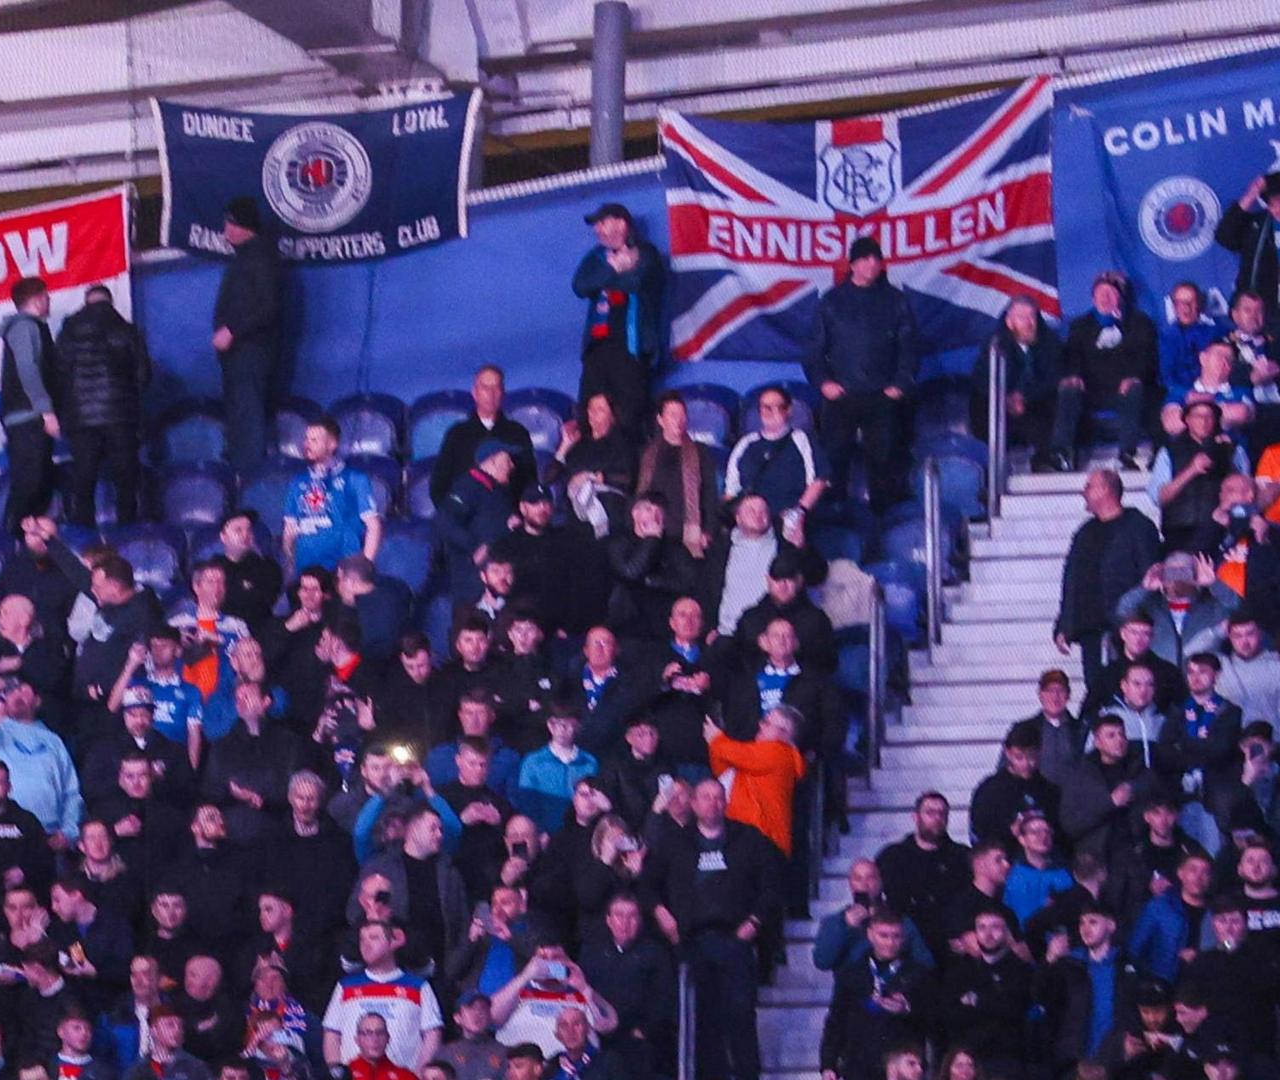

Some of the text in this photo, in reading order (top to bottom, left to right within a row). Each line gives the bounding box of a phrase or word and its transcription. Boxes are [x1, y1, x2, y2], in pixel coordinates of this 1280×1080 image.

[181, 111, 256, 143] DUNDEE
[392, 105, 450, 137] LOYAL
[1103, 107, 1229, 157] COLIN
[397, 215, 441, 249] CLUB
[707, 189, 1006, 262] ENNISKILLEN
